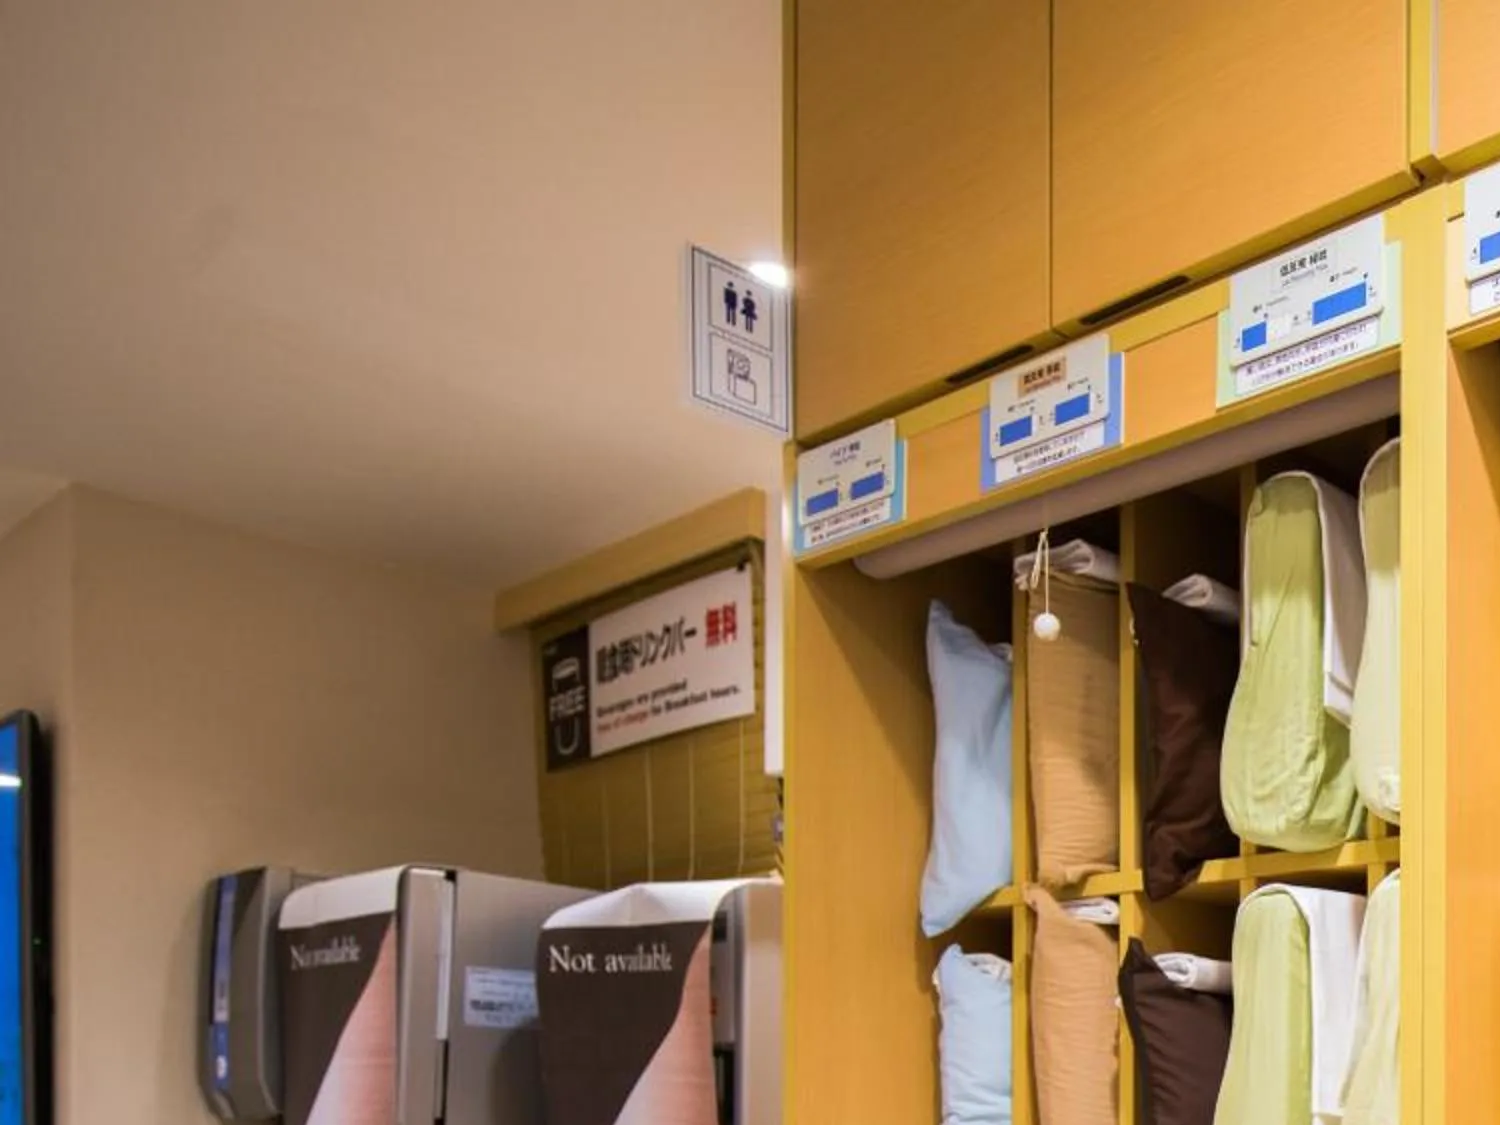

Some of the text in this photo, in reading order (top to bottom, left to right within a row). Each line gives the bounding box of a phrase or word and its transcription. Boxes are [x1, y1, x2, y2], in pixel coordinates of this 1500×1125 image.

[705, 600, 738, 647] 無料
[549, 685, 586, 722] FREE
[548, 942, 673, 974] Not available
